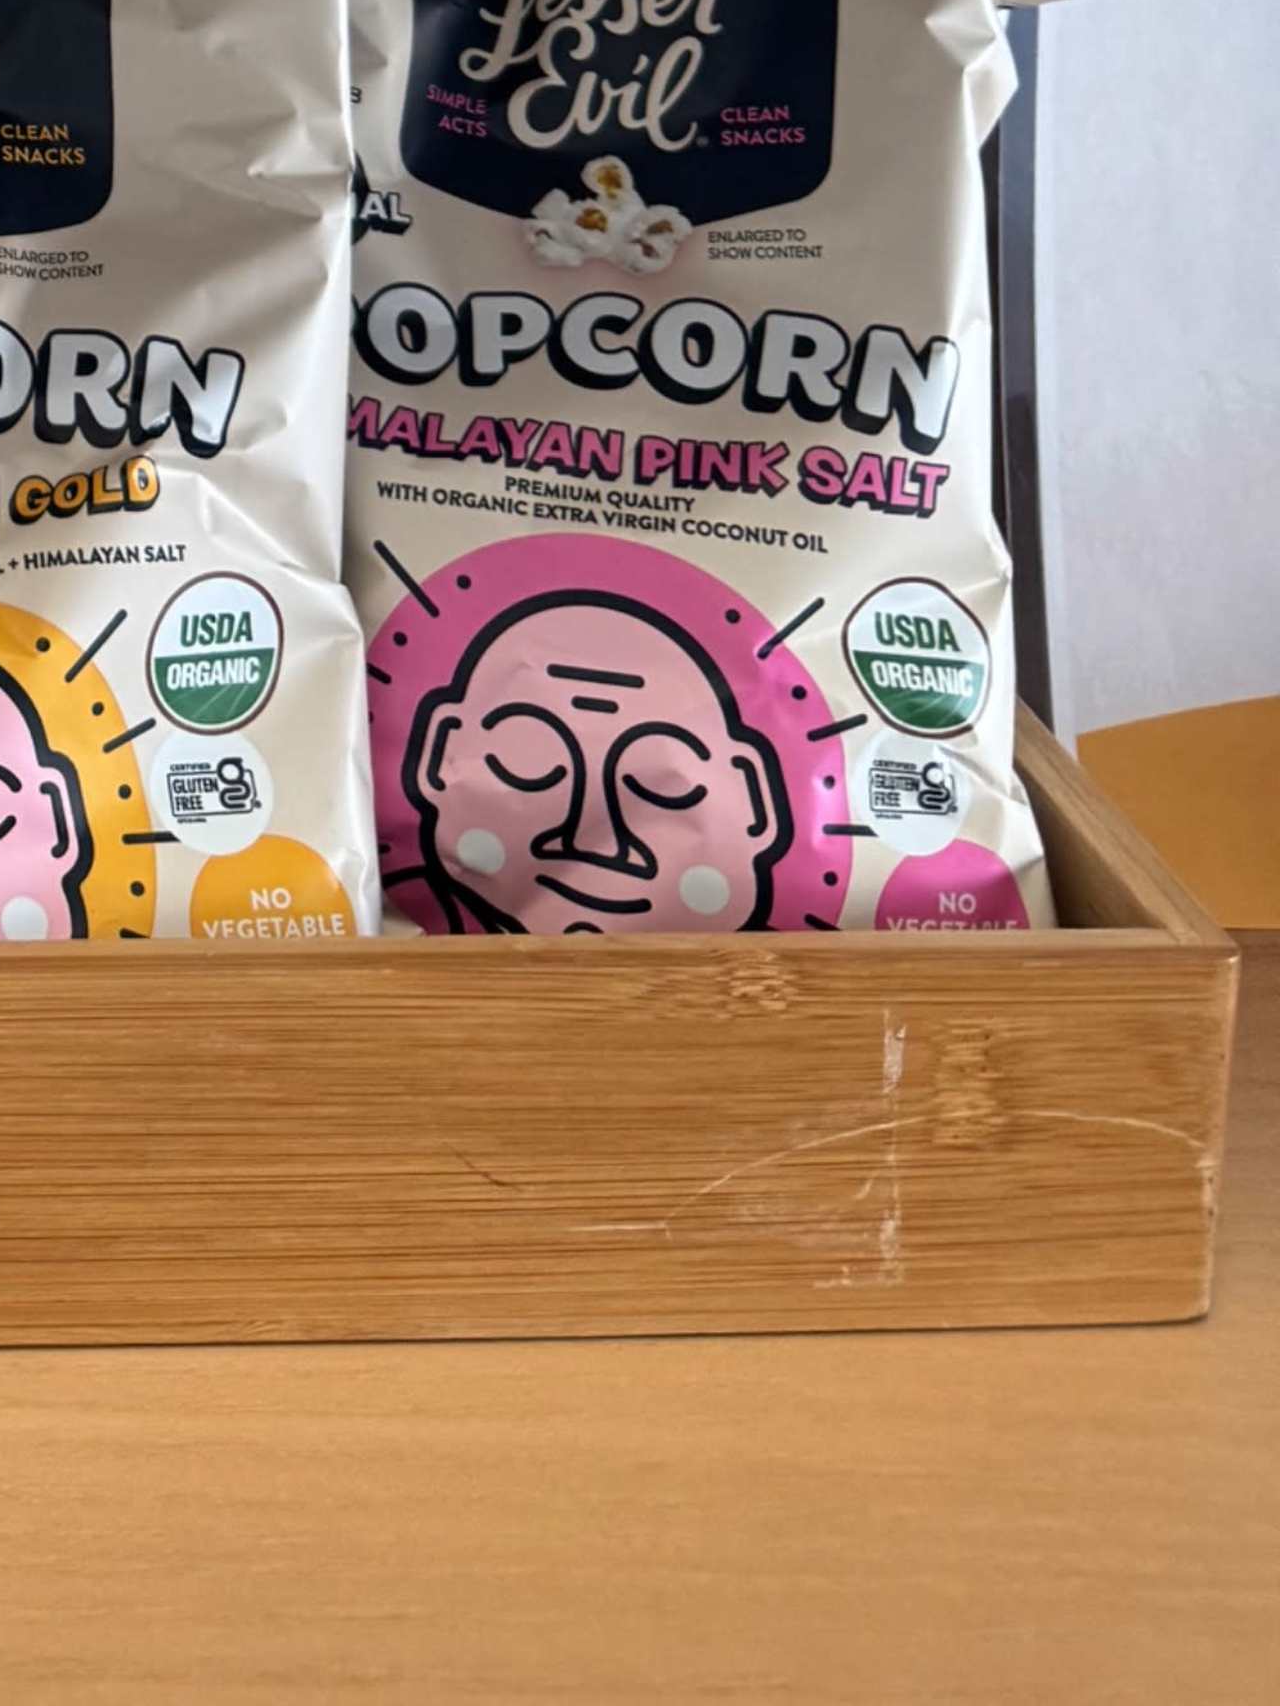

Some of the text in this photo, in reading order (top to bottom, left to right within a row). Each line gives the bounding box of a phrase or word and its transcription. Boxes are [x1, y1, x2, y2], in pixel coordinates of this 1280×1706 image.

[427, 84, 487, 116] SIMPLE
[507, 36, 703, 152] Evil
[439, 113, 488, 137] ACTS
[720, 105, 790, 123] CLEAN
[0, 124, 69, 141] CLEAN
[720, 127, 805, 146] SNACKS
[1, 147, 86, 165] SNACKS
[708, 229, 806, 244] ENLARGED TO
[69, 252, 88, 265] TO
[708, 245, 823, 260] SHOW CONTENT
[39, 264, 104, 280] CONTENT
[351, 282, 960, 455] OPCORN
[347, 394, 950, 518] MALAYAN PINK SALT
[10, 454, 161, 523] GOLD
[505, 476, 695, 513] PREMIUM QUALITY
[377, 480, 828, 554] WITH ORGANIC EXTRA VIRGIN COCONUT OIL
[24, 545, 140, 571] HIMALAYAN
[144, 545, 187, 564] SALT
[180, 611, 253, 647] USDA
[875, 612, 960, 652] USDA
[167, 657, 261, 690] ORGANIC
[871, 659, 974, 698] ORGANIC
[172, 777, 219, 795] GLUTEN
[175, 796, 203, 811] FREE
[873, 791, 901, 807] FREE
[250, 888, 293, 910] NO
[939, 891, 977, 915] NO
